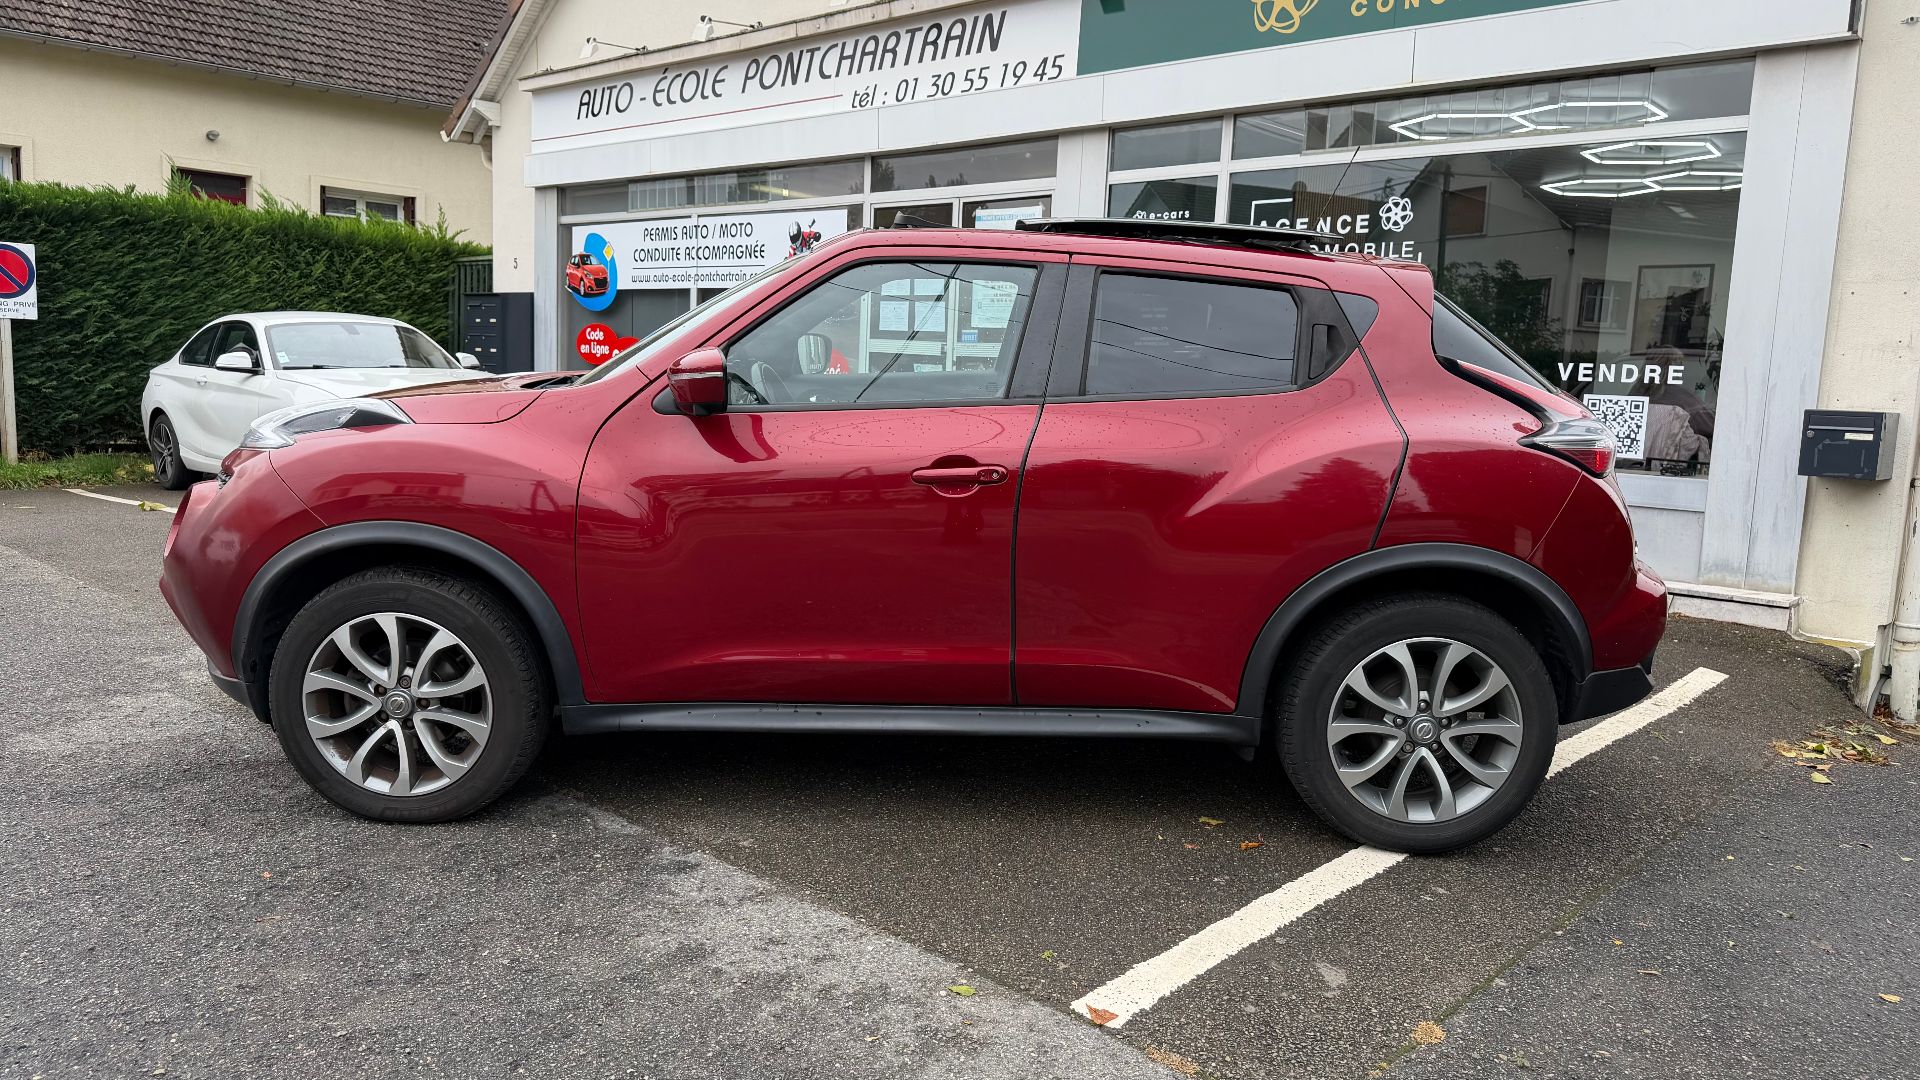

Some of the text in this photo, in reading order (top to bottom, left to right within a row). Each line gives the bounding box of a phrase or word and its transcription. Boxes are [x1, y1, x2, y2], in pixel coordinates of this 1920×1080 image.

[1350, 0, 1446, 17] CON
[577, 82, 634, 120] AUTO
[652, 65, 729, 107] ÉCOLE
[741, 10, 1007, 94] PONTCHARTRAIN
[895, 77, 919, 103] 01
[926, 71, 956, 99] 30
[960, 66, 990, 93] 55
[1000, 60, 1028, 88] 19
[1033, 54, 1065, 82] 45
[643, 226, 678, 242] PERMIS
[682, 224, 709, 240] AUTO
[719, 222, 754, 239] MOTO
[633, 240, 765, 263] CONDUITE ACCOMPAGNÉE
[513, 257, 519, 270] 5
[586, 328, 604, 341] Code
[580, 344, 590, 354] en
[590, 341, 610, 357] Ligne
[1558, 362, 1685, 385] VENDRE
